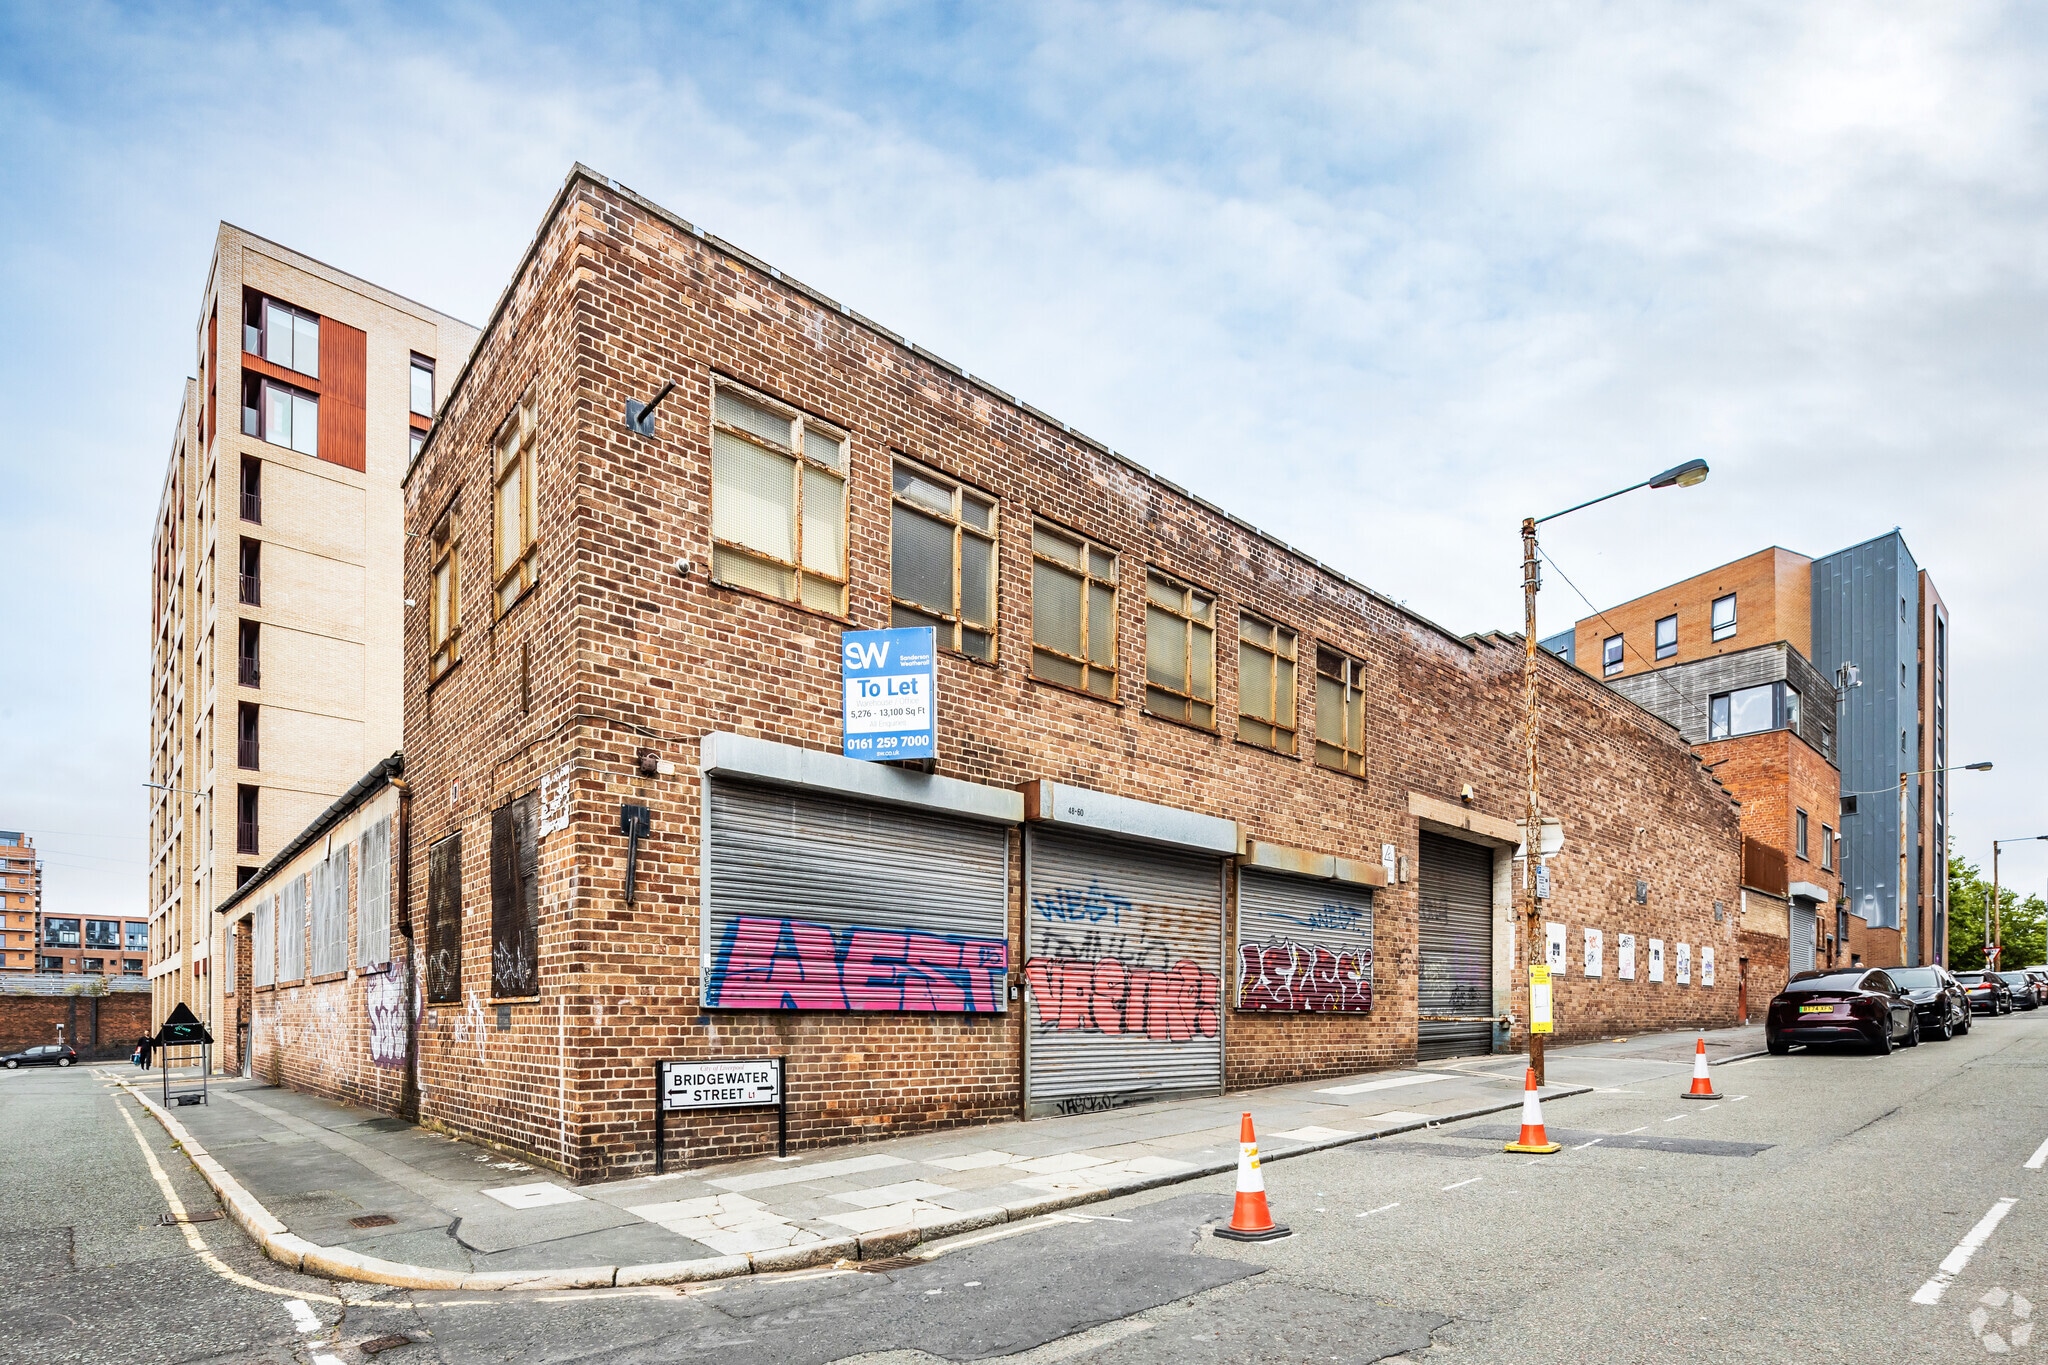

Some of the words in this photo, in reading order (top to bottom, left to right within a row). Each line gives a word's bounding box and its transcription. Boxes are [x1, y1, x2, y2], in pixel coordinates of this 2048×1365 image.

[845, 641, 890, 670] SW
[857, 679, 881, 698] To
[887, 678, 918, 696] Let
[856, 699, 893, 708] Warehouse
[851, 709, 872, 719] 5,276
[880, 707, 904, 718] 13,100
[905, 707, 916, 716] Sq
[917, 706, 925, 715] Ft
[847, 738, 873, 750] 0161
[876, 736, 898, 749] 259
[900, 734, 930, 747] 7000
[1067, 806, 1084, 817] 48-60
[720, 1064, 745, 1072] Liverpool
[674, 1072, 769, 1087] BRIDGEWATER
[693, 1088, 744, 1102] STREET
[748, 1091, 755, 1099] L1
